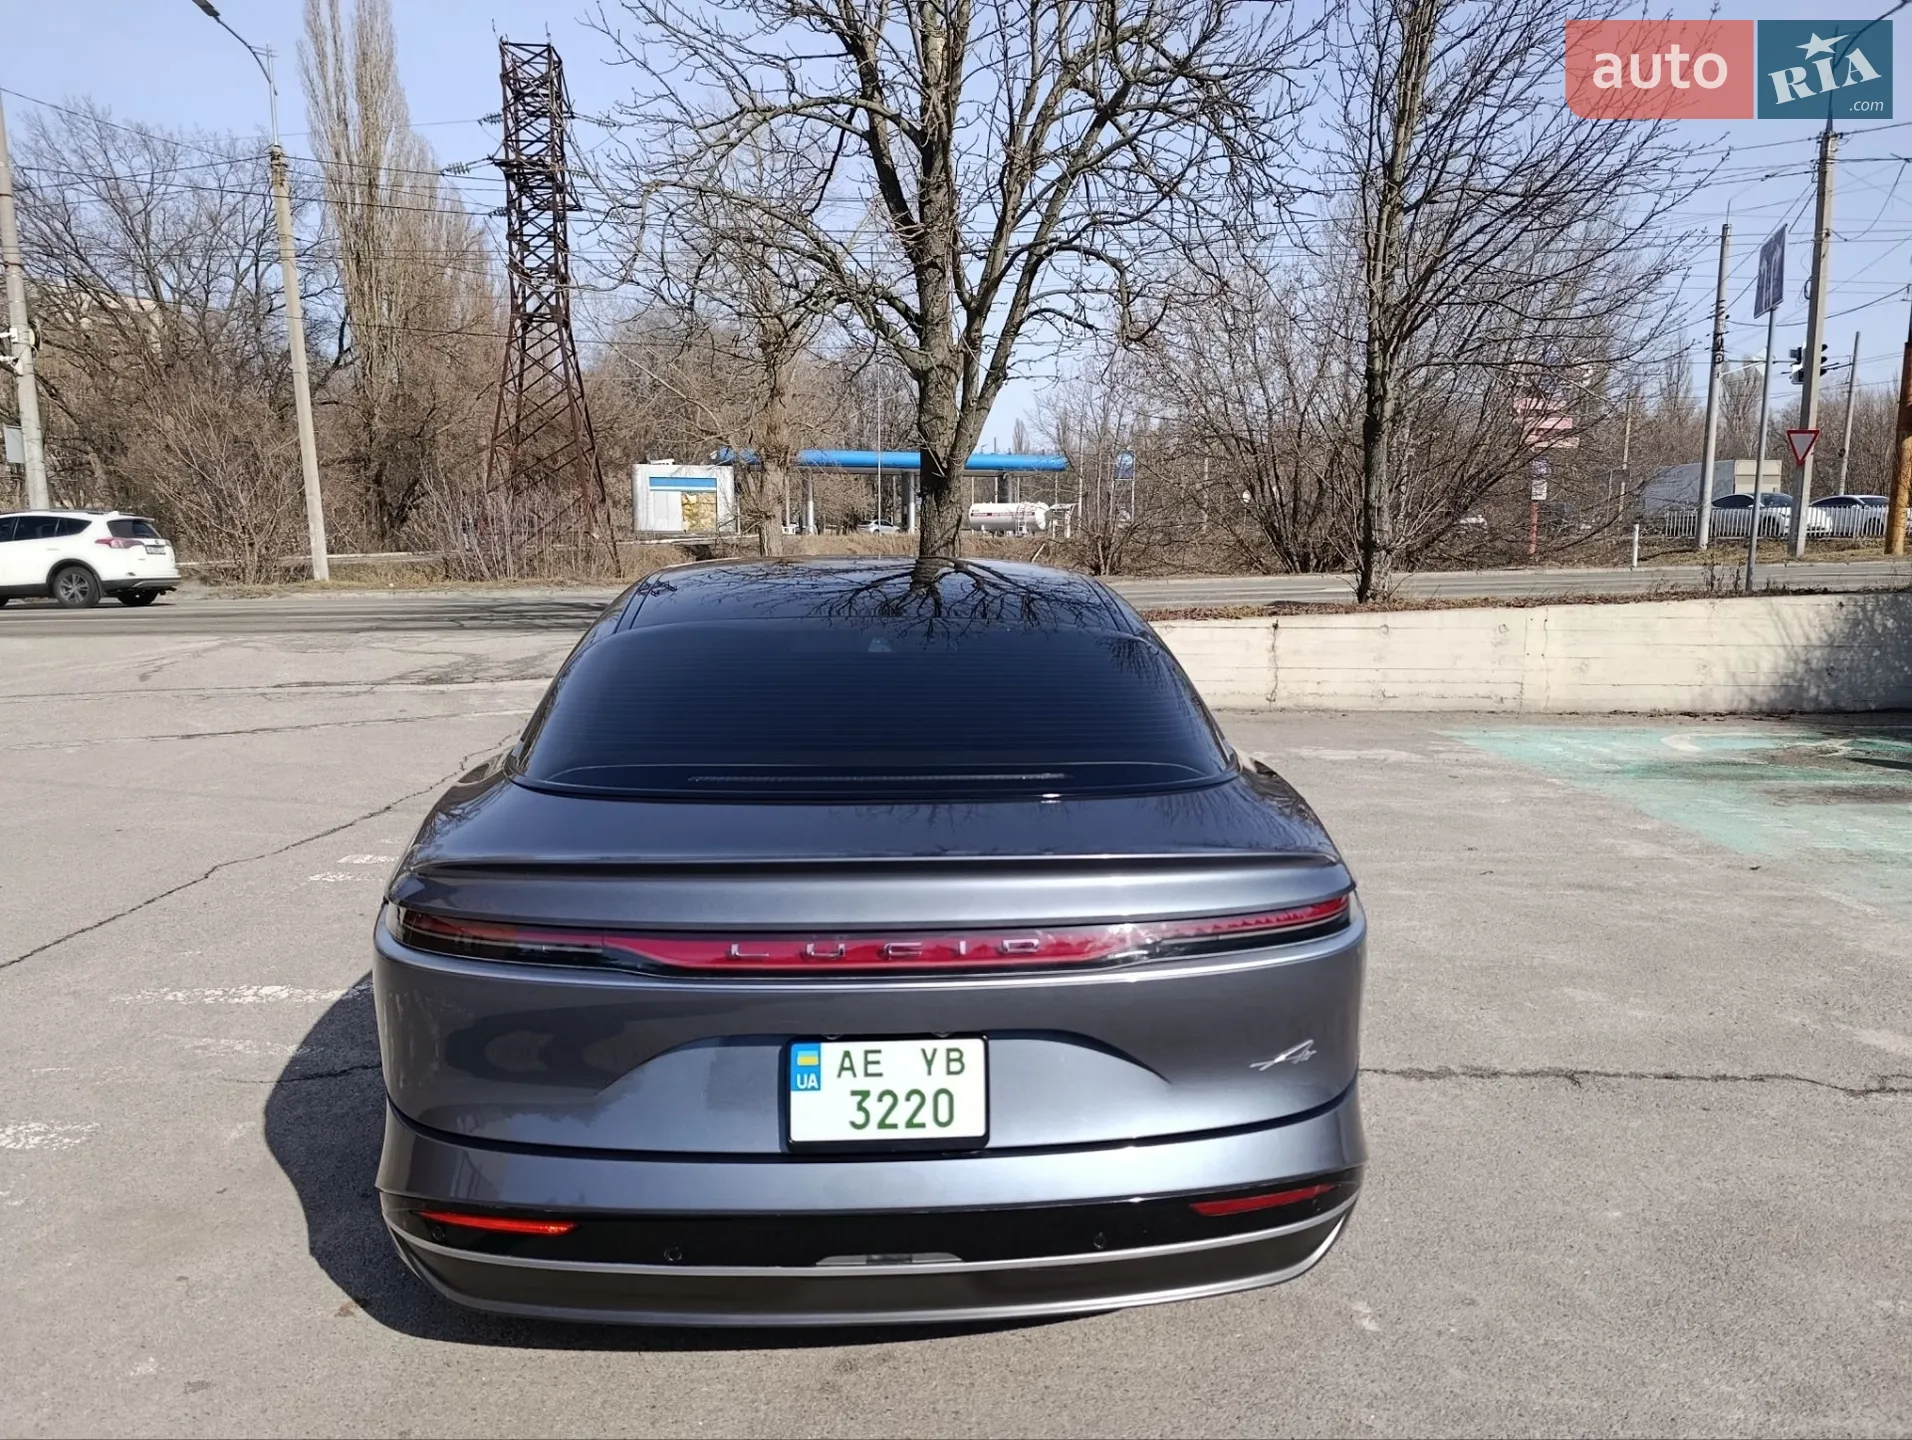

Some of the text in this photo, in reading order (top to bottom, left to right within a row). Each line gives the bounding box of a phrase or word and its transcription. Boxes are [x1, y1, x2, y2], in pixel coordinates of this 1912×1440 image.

[731, 939, 1040, 958] LUCID
[836, 1047, 966, 1079] AE YB
[796, 1073, 819, 1090] UA
[848, 1087, 955, 1131] 3220
